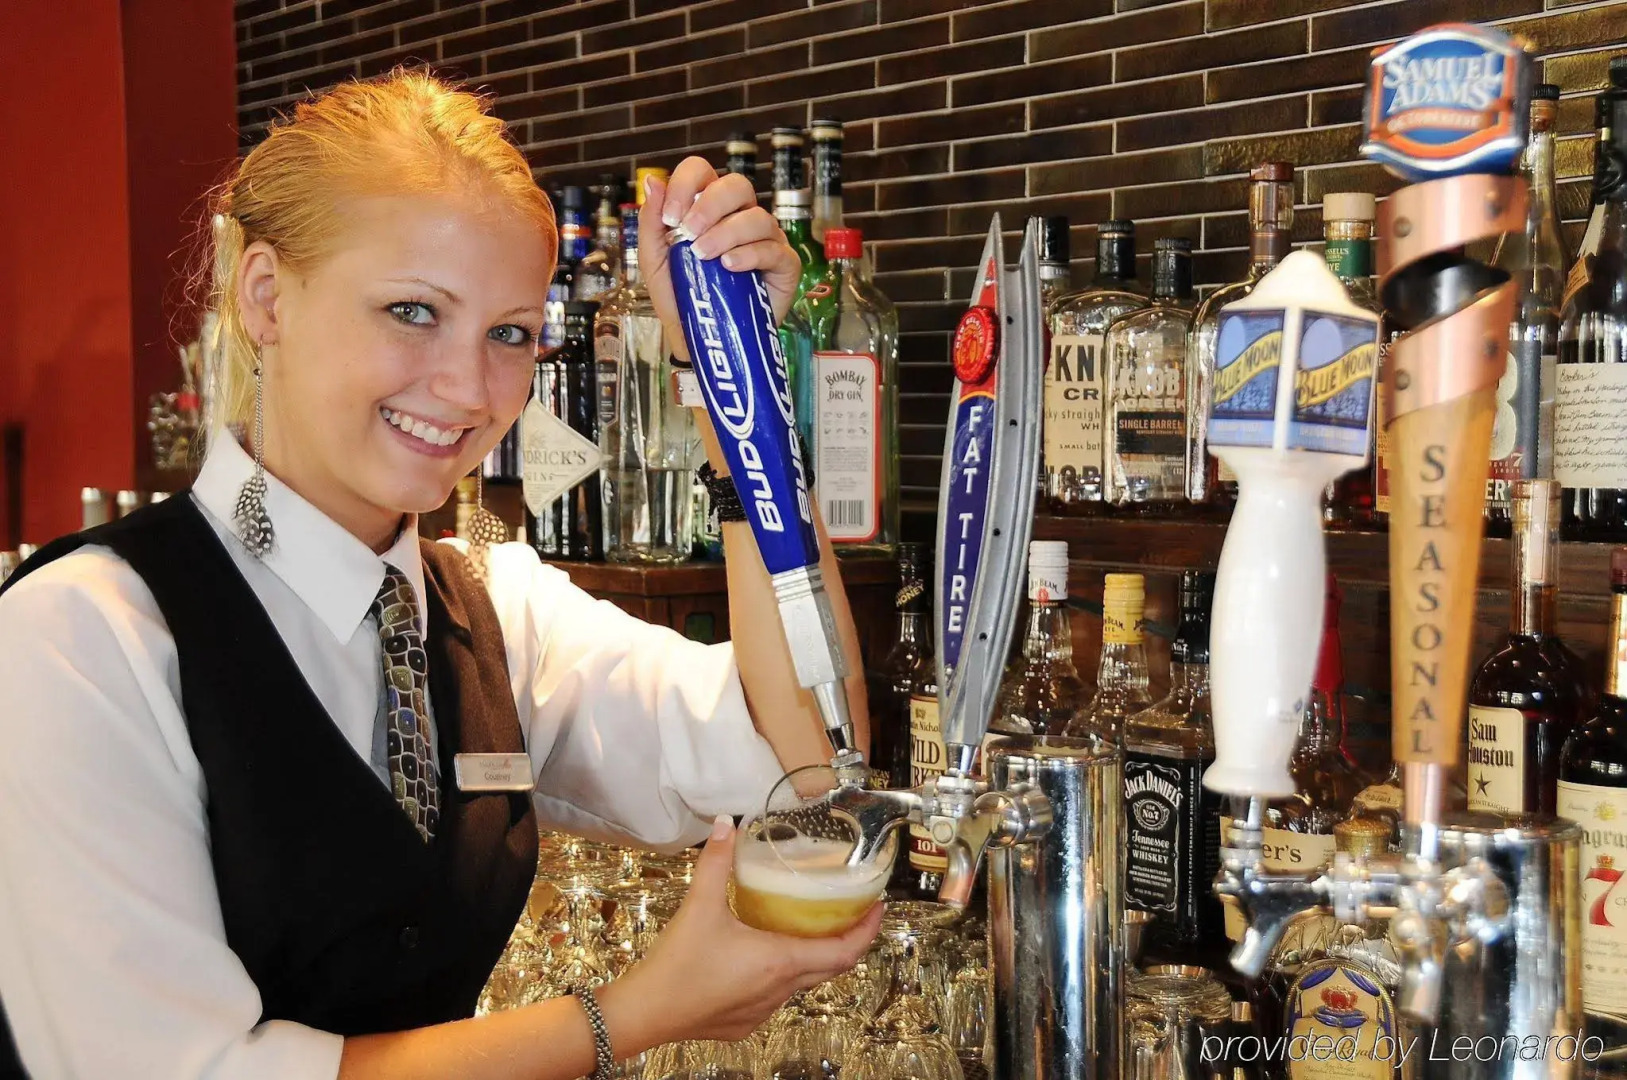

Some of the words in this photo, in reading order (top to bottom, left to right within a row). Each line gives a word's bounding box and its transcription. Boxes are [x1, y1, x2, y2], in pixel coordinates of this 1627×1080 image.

[1383, 52, 1503, 88] SAMUEL
[1386, 80, 1494, 111] ADAMS
[690, 288, 746, 418] LIGHT
[1055, 345, 1095, 382] KN
[825, 370, 867, 386] BOMBAY
[1213, 361, 1242, 402] BLUE
[1296, 366, 1338, 405] BLUE
[1341, 349, 1374, 379] MOON
[829, 390, 844, 400] DRY
[847, 390, 862, 400] GIN
[1064, 388, 1099, 400] CR
[1061, 407, 1101, 422] straigh
[1119, 419, 1149, 429] SINGLE
[1150, 419, 1182, 430] BARREL
[524, 449, 586, 465] DRICK'S
[963, 406, 982, 494] FAT
[738, 440, 784, 532] BUD
[948, 513, 974, 632] TIRE
[1409, 445, 1447, 754] SEASONAL
[1471, 717, 1498, 743] Sam
[1125, 773, 1146, 799] JACK
[1146, 770, 1184, 809] DANIEL'S
[917, 839, 938, 853] 101
[1132, 829, 1170, 849] Tennessee
[1261, 844, 1302, 863] er's
[1132, 849, 1169, 865] WHISKEY
[1584, 865, 1625, 928] 7
